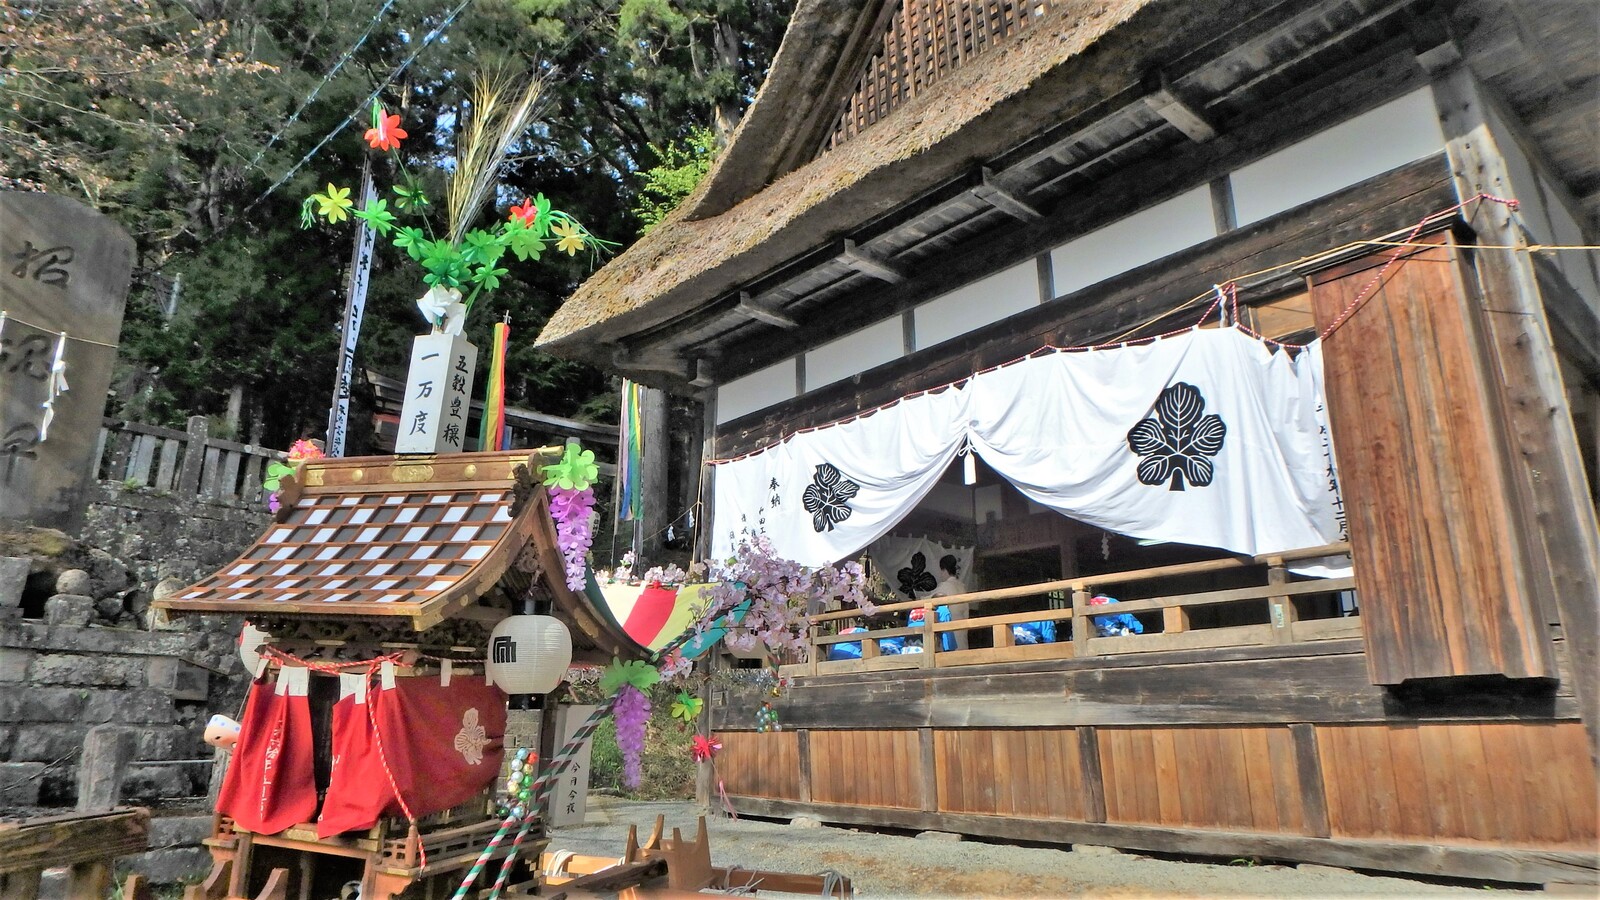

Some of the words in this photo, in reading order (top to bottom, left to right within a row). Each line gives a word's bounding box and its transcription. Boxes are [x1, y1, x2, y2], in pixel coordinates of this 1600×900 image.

[409, 353, 440, 436] 一万度
[768, 476, 781, 509] 奉納
[566, 762, 581, 815] 今月今夜
